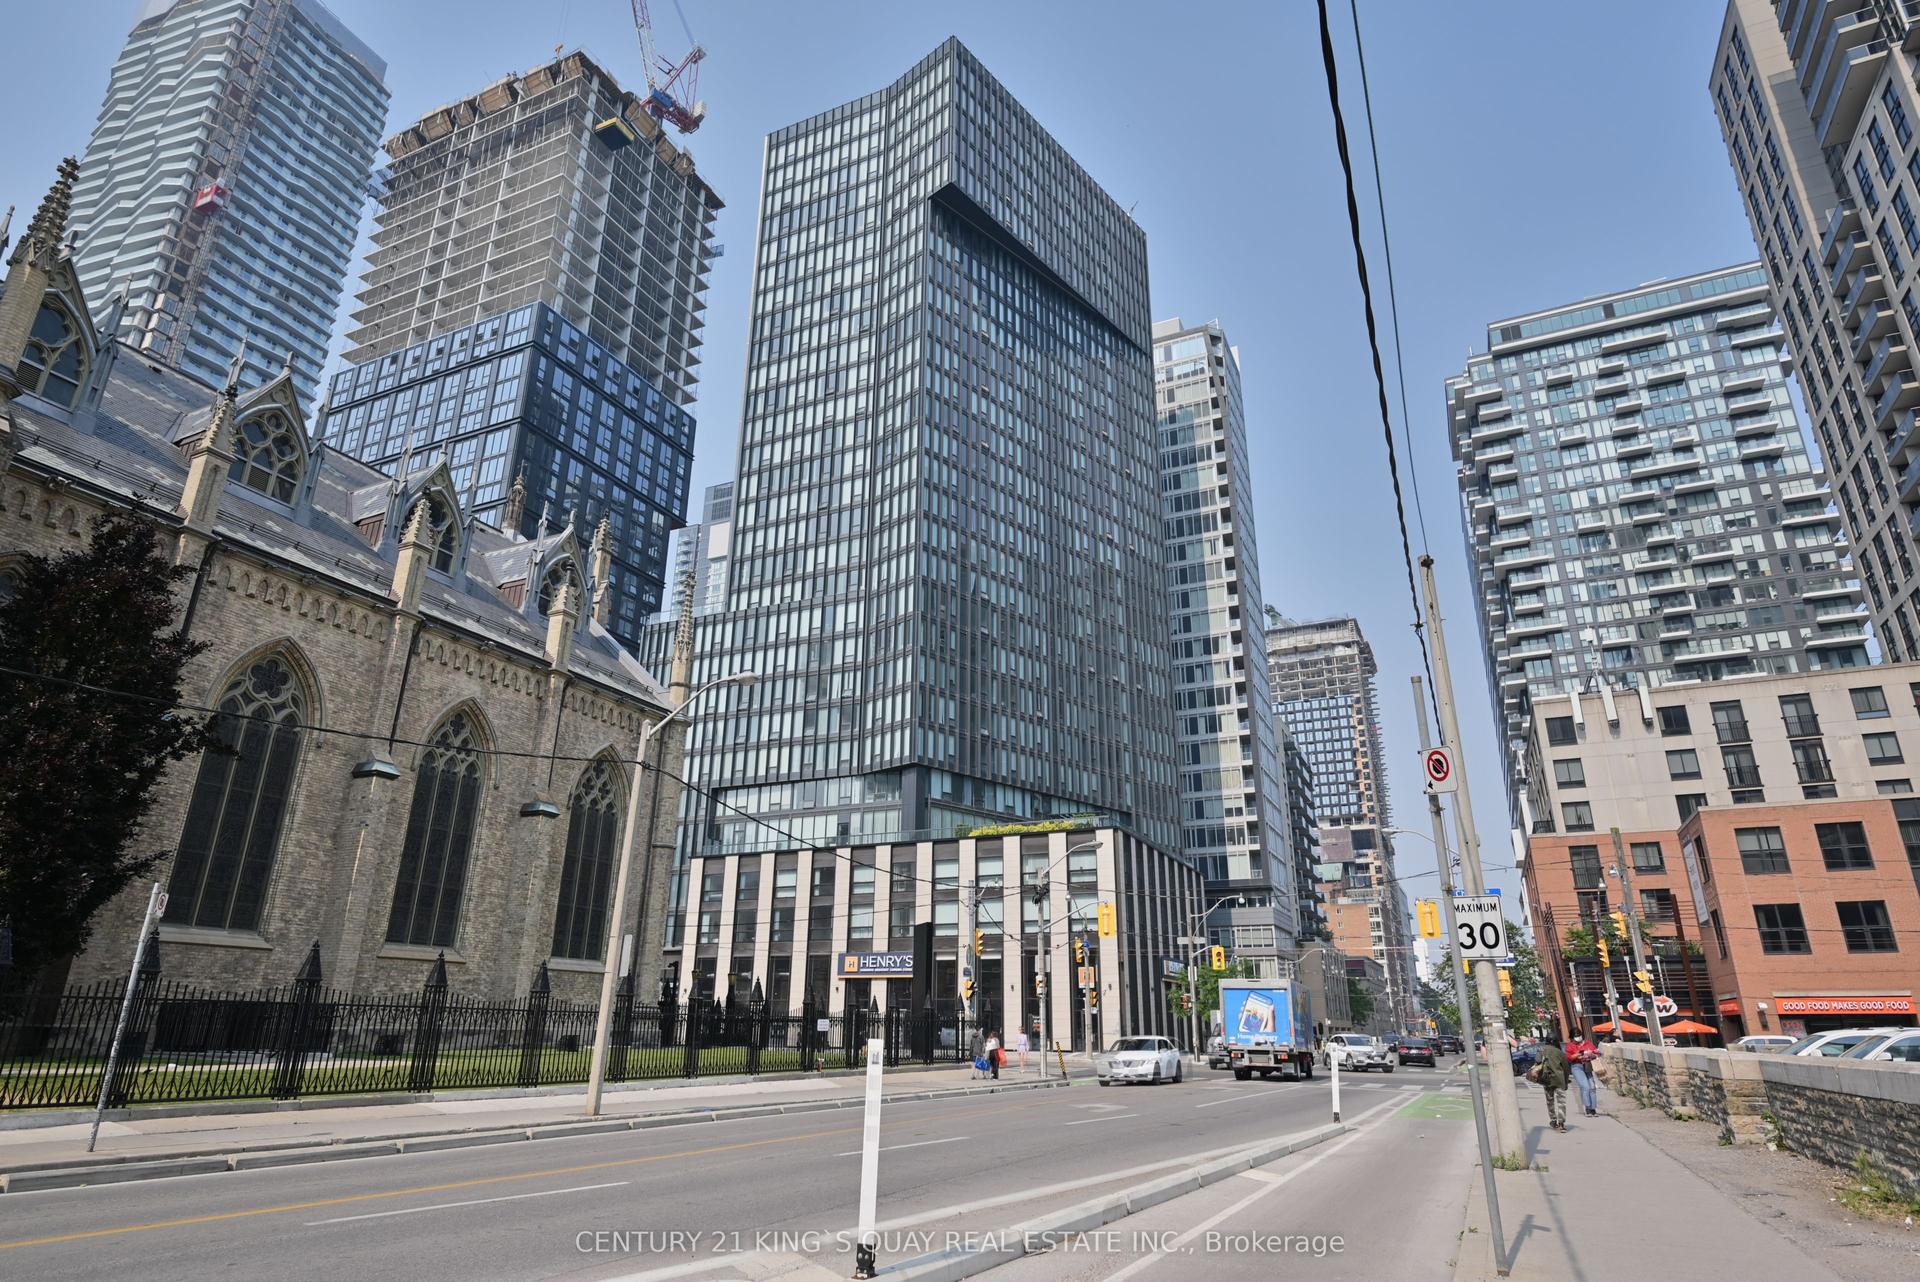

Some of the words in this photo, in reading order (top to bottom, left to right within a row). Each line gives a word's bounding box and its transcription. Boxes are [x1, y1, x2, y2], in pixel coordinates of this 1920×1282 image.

[1454, 903, 1498, 913] MAXIMUM
[1458, 922, 1500, 950] 30
[860, 955, 913, 968] HENRY'S
[1783, 1002, 1806, 1010] GOOD
[1808, 1001, 1830, 1010] FOOD
[1832, 1001, 1859, 1010] MAKES
[1860, 1001, 1884, 1010] GOOD
[1886, 1001, 1910, 1010] FOOD
